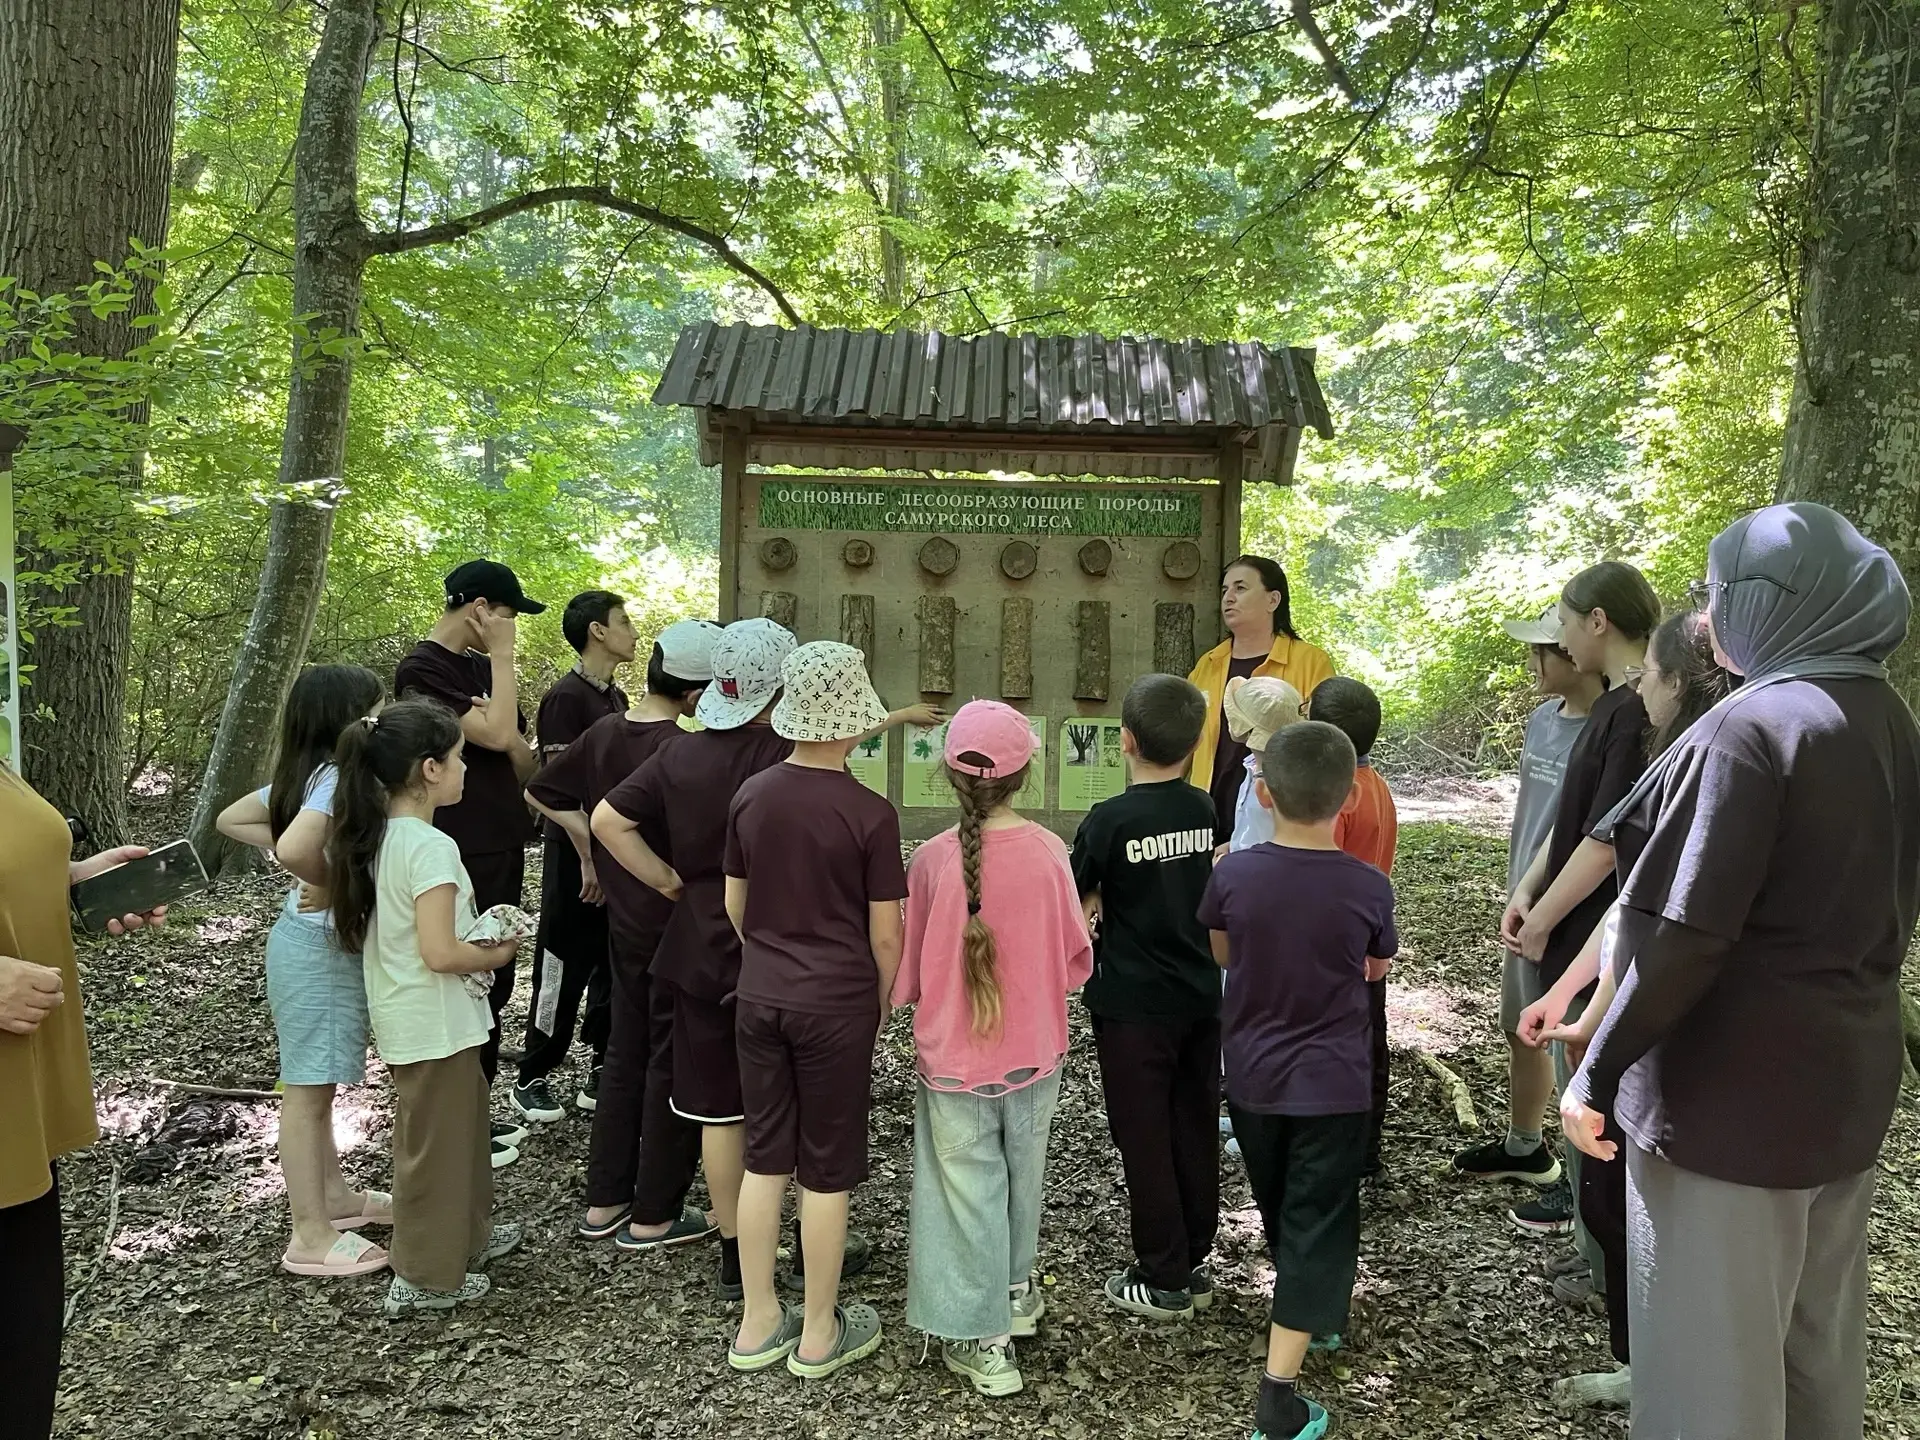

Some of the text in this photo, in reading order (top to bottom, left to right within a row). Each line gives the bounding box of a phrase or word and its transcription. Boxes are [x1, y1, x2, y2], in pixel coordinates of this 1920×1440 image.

[777, 489, 1181, 513] ОСНОВНЫЕ ЛЕСООБРАЗУЮЩИЕ ПОРОДЫ
[885, 511, 1073, 529] САМУРСКОГО ЛЕСА
[1529, 772, 1558, 786] nothing
